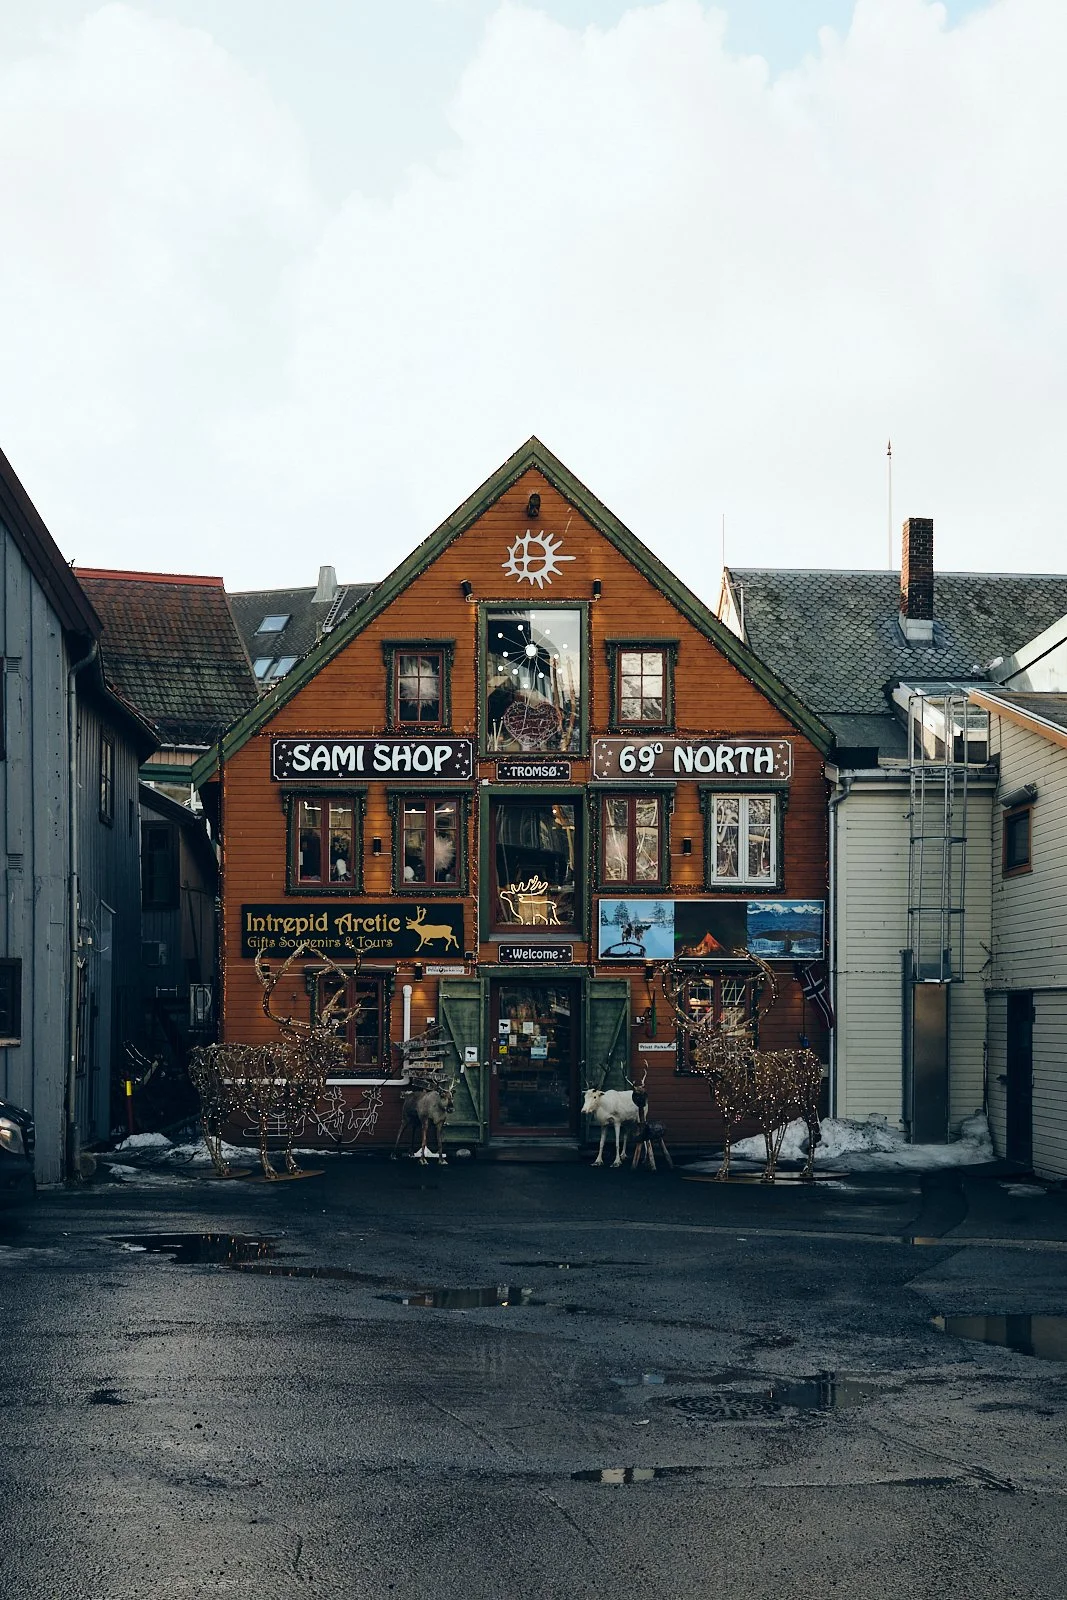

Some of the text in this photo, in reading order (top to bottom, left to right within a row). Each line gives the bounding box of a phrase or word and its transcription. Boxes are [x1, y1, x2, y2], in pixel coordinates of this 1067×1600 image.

[292, 745, 453, 772] SAMI SHOP
[673, 746, 775, 774] NORTH
[510, 766, 557, 777] TROMSØ
[246, 912, 401, 936] Intrepid Arctic
[247, 936, 276, 949] Gifts
[278, 936, 341, 948] Souvenirs
[356, 936, 393, 948] Tours
[512, 949, 559, 960] Welcome
